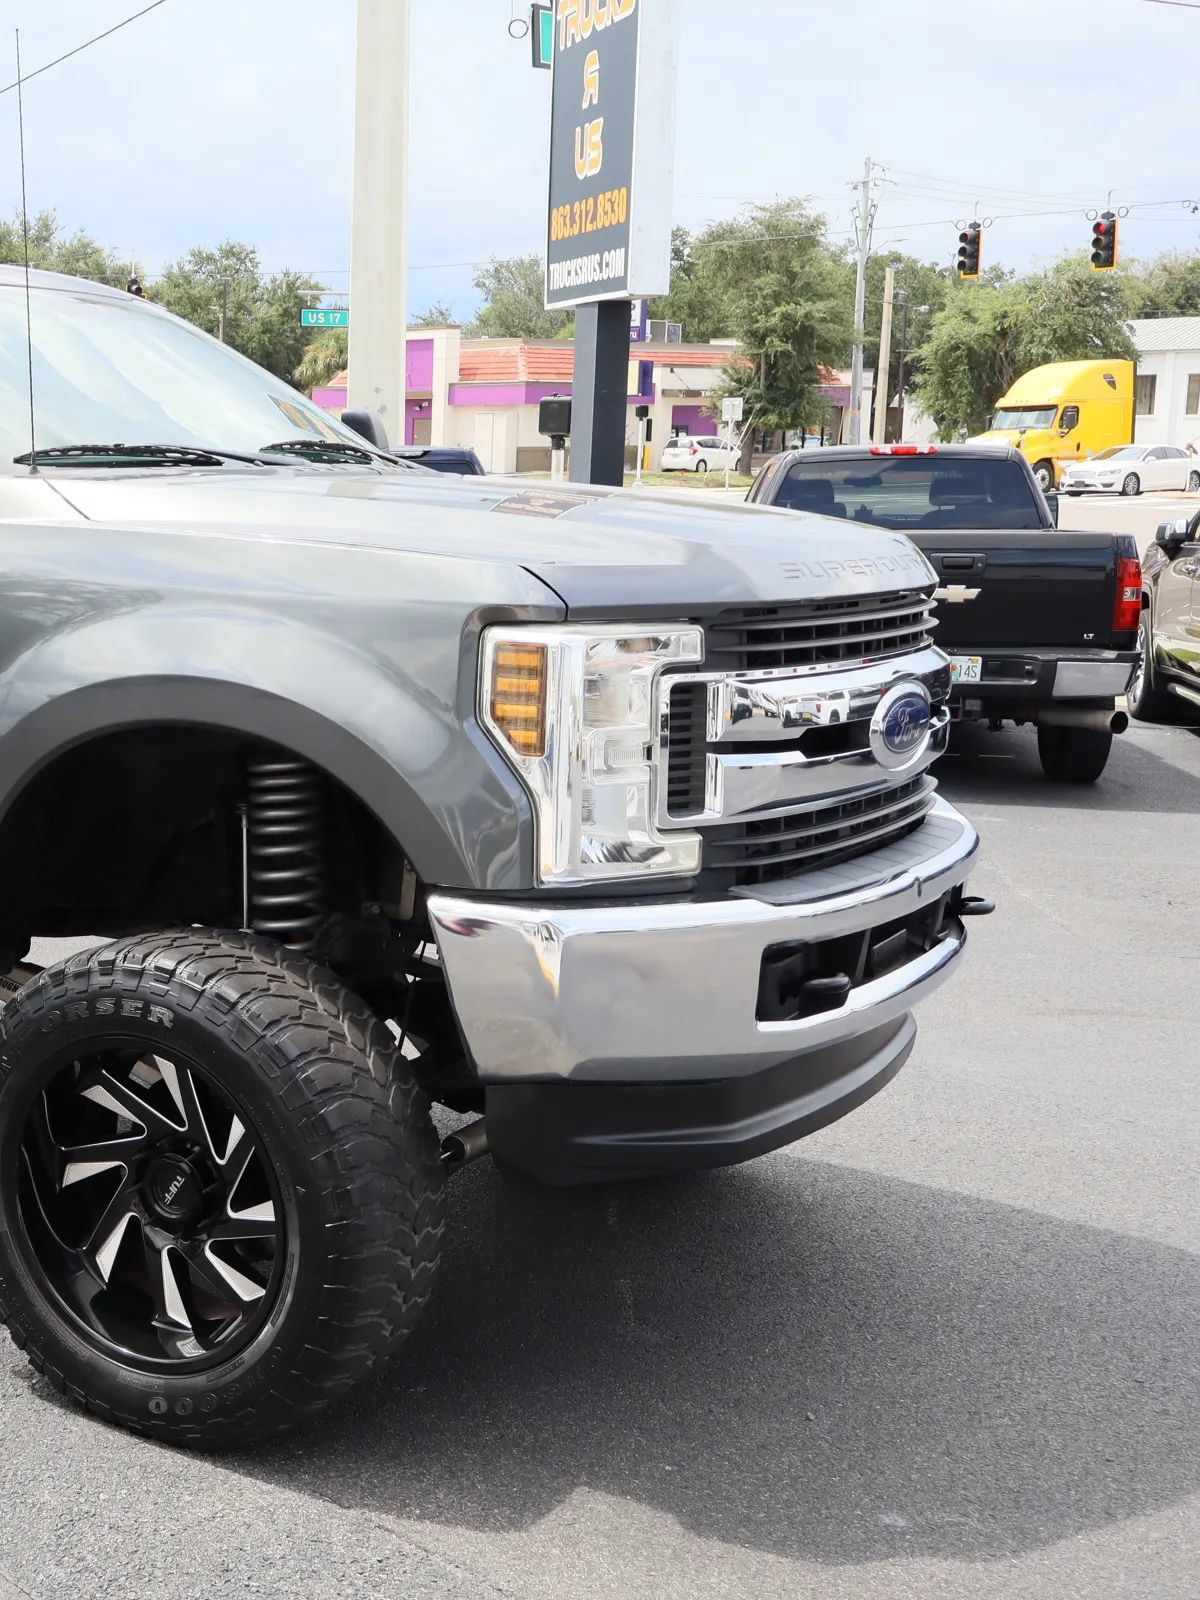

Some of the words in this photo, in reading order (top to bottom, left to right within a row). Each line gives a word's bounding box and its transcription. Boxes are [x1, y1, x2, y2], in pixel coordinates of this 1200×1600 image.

[574, 116, 604, 181] US
[551, 187, 627, 241] 863.312.8530
[550, 247, 625, 290] TRUCKSRUS.COM
[308, 312, 325, 324] US
[330, 312, 341, 324] 17
[164, 1174, 186, 1206] TUFF
